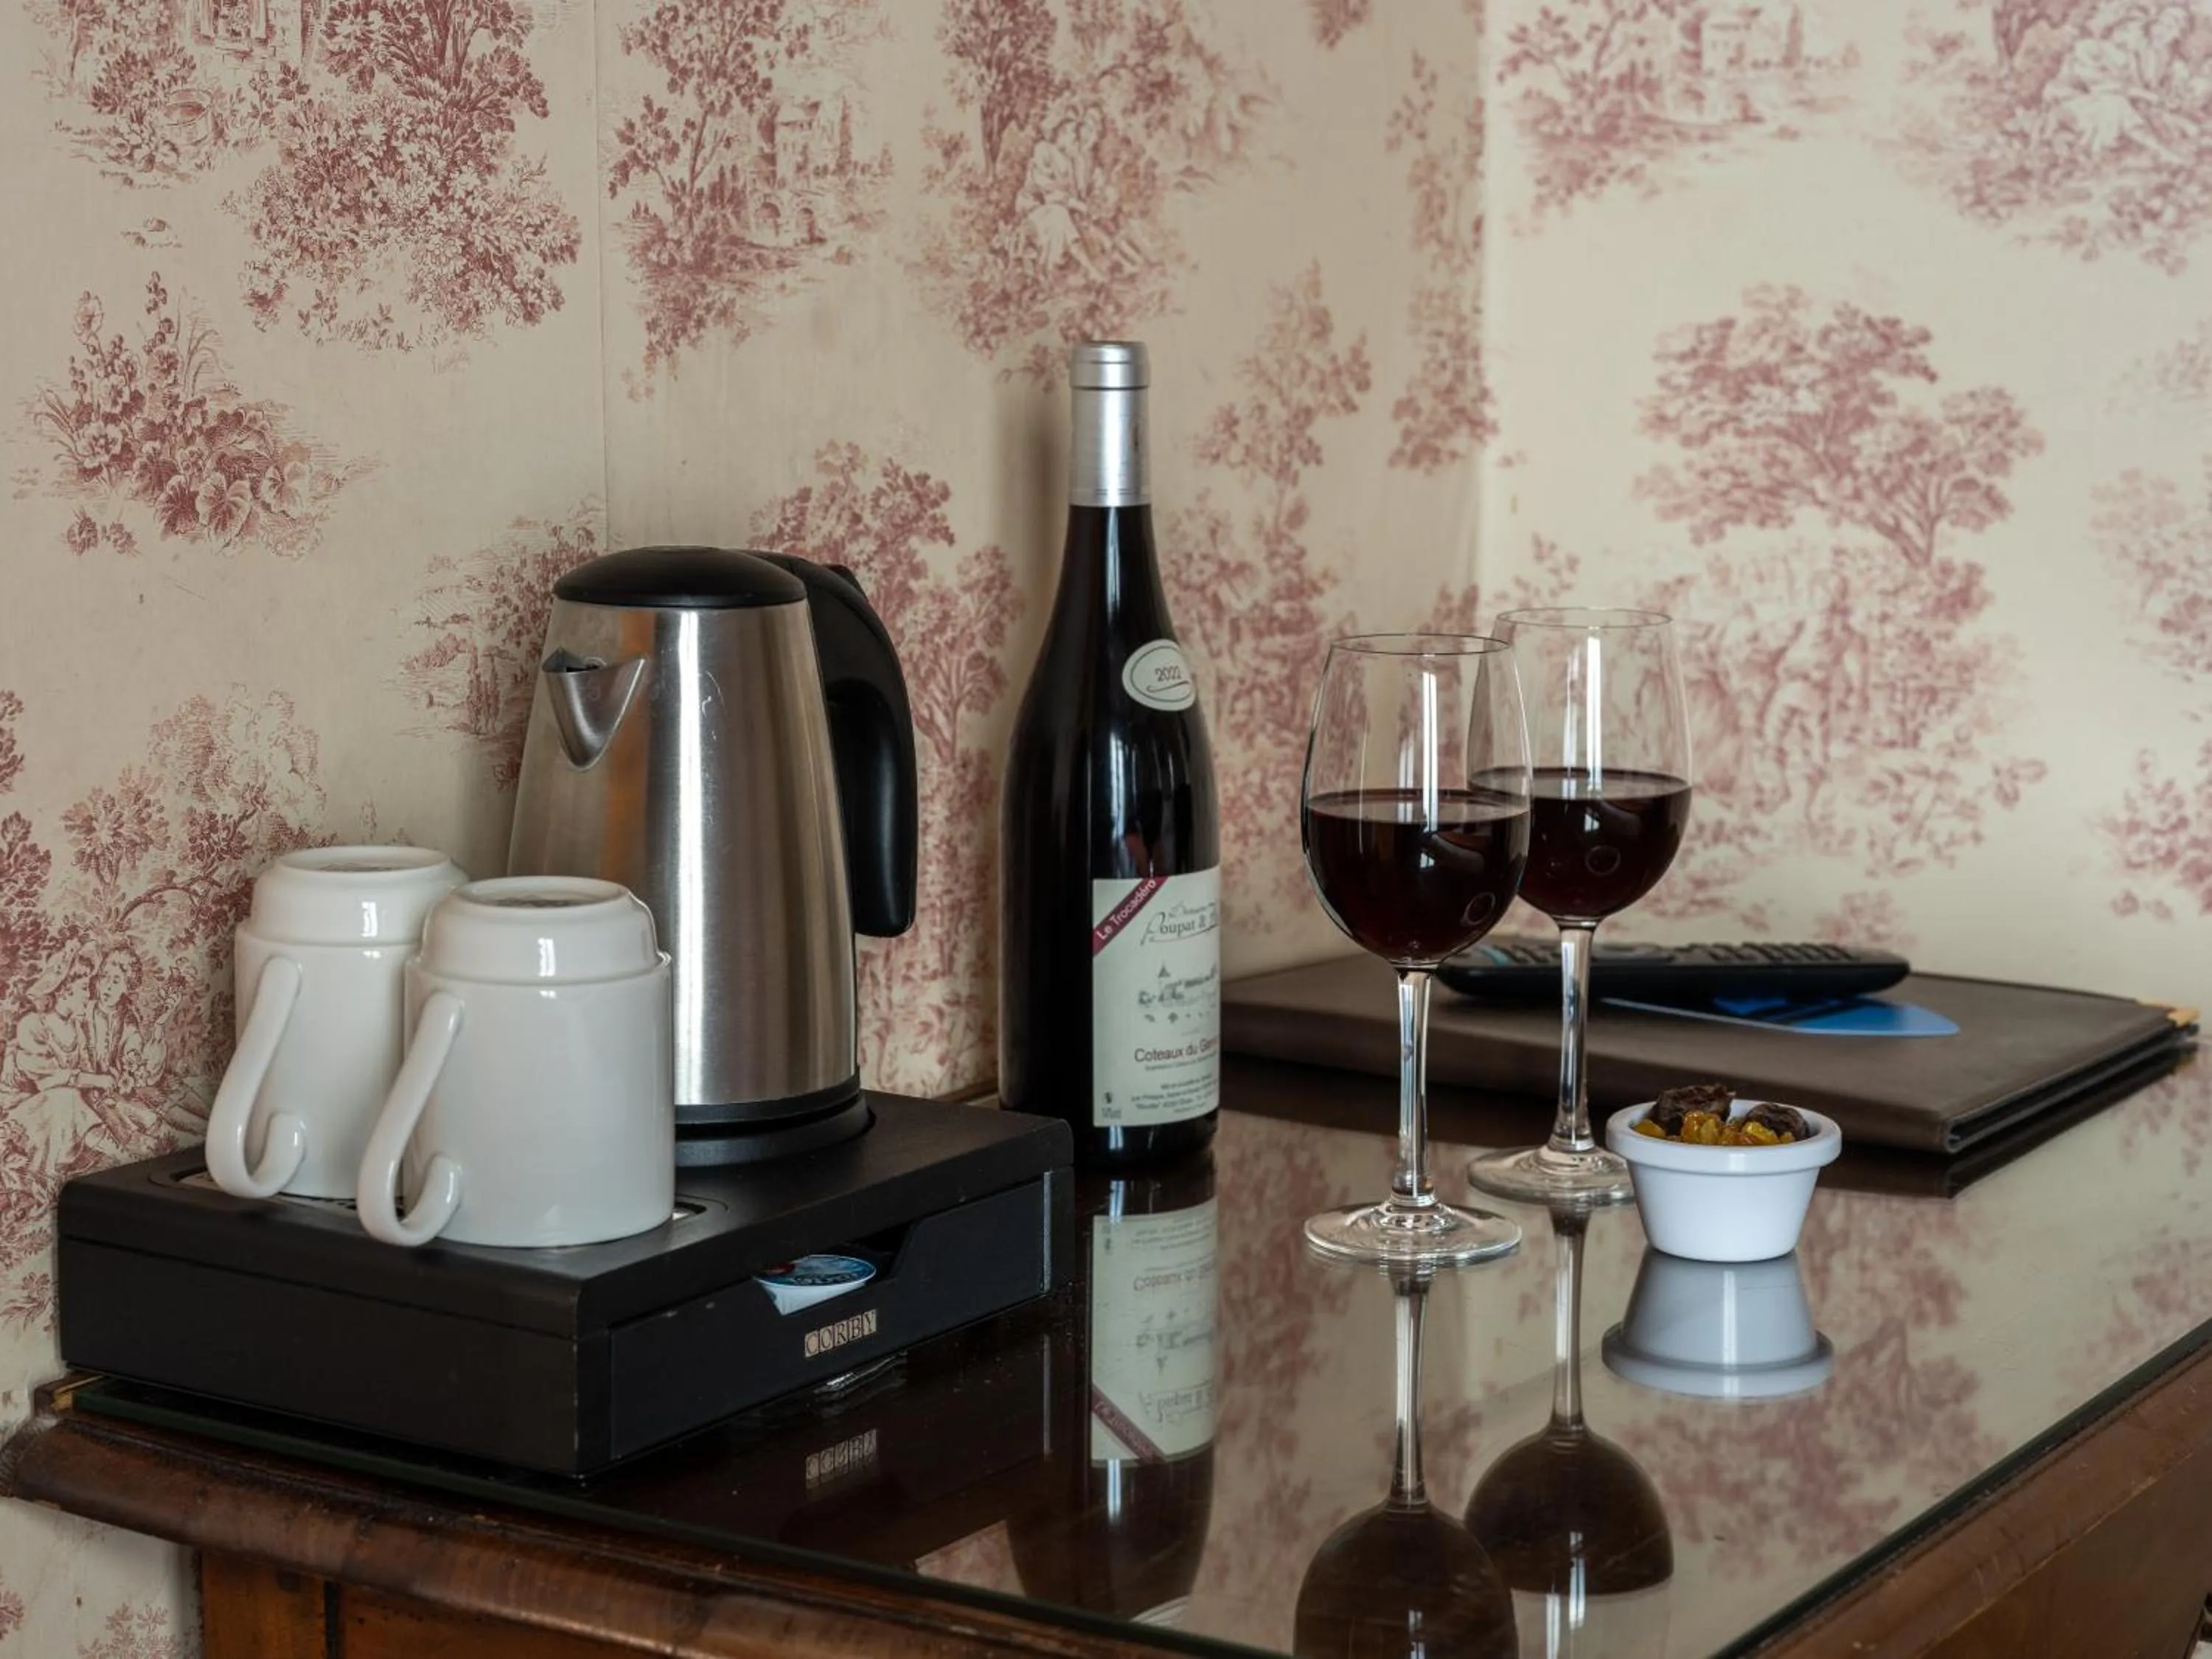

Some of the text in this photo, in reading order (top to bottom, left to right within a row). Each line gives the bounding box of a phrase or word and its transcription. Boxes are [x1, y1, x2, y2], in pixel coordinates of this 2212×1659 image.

[1096, 925, 1113, 940] Le
[1134, 1048, 1183, 1062] Coteaux
[805, 1310, 876, 1357] CORBY
